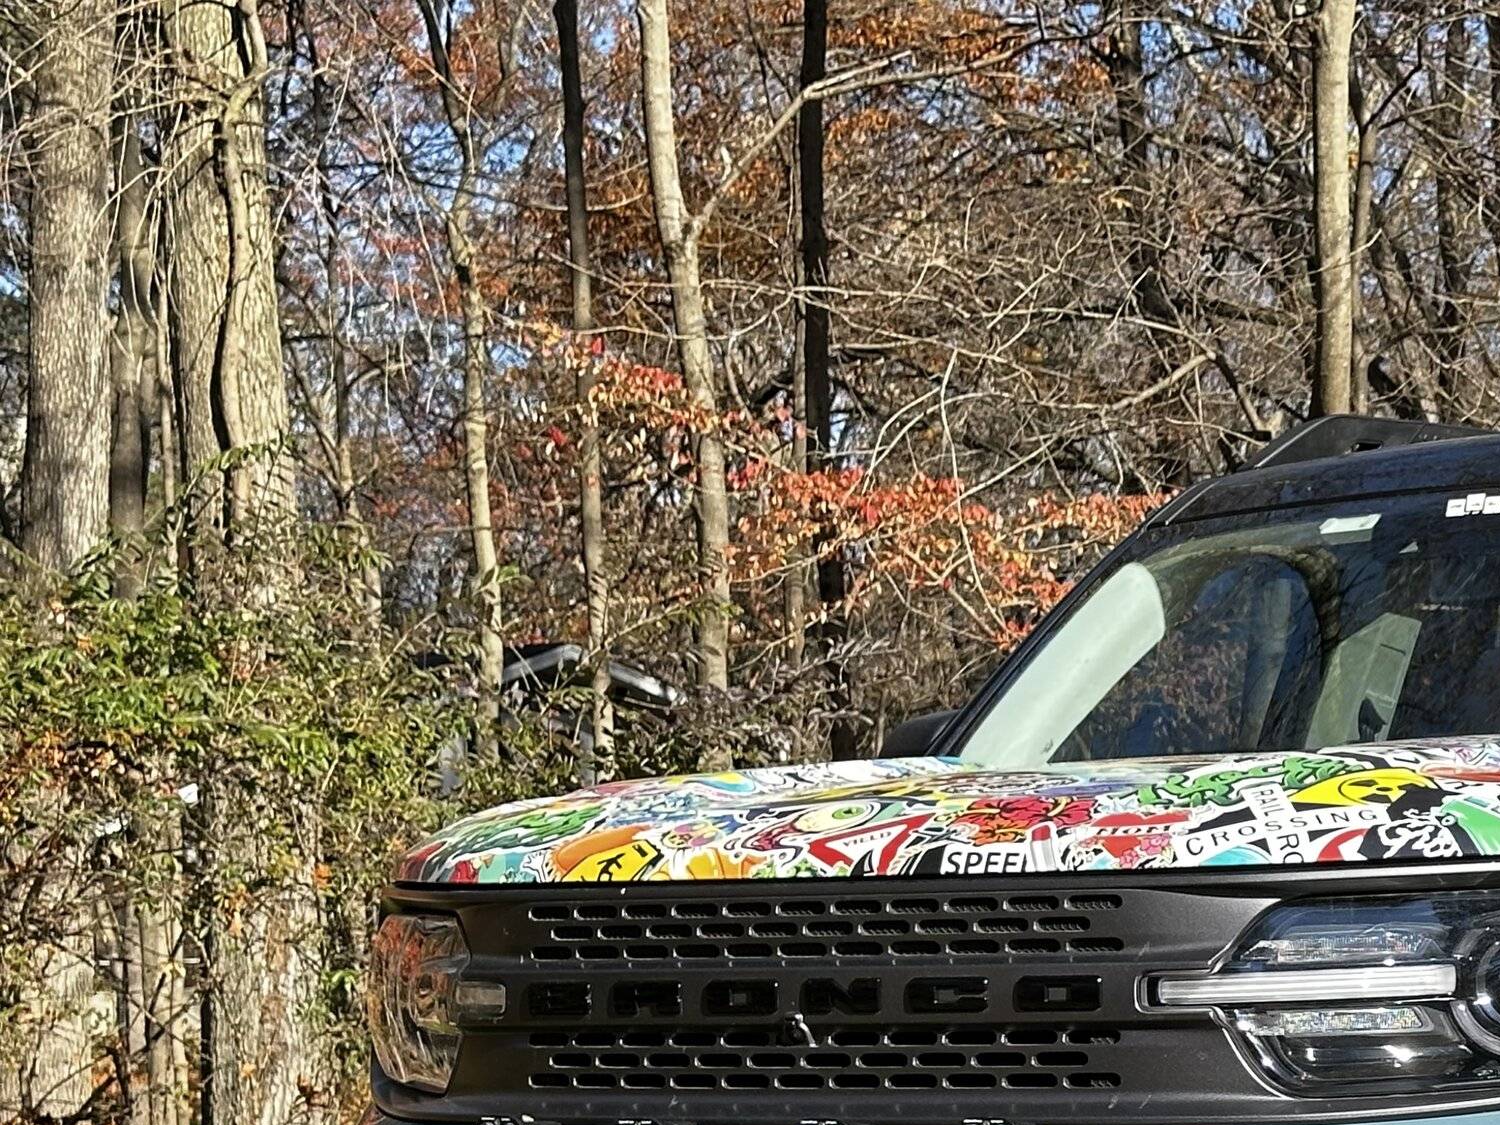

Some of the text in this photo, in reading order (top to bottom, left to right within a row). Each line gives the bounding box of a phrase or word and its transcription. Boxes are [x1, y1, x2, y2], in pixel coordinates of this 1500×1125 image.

[1251, 788, 1286, 817] RAIL
[1185, 809, 1378, 856] CROSSING
[946, 851, 1028, 874] SPEE
[524, 974, 1102, 1018] BRONCO
